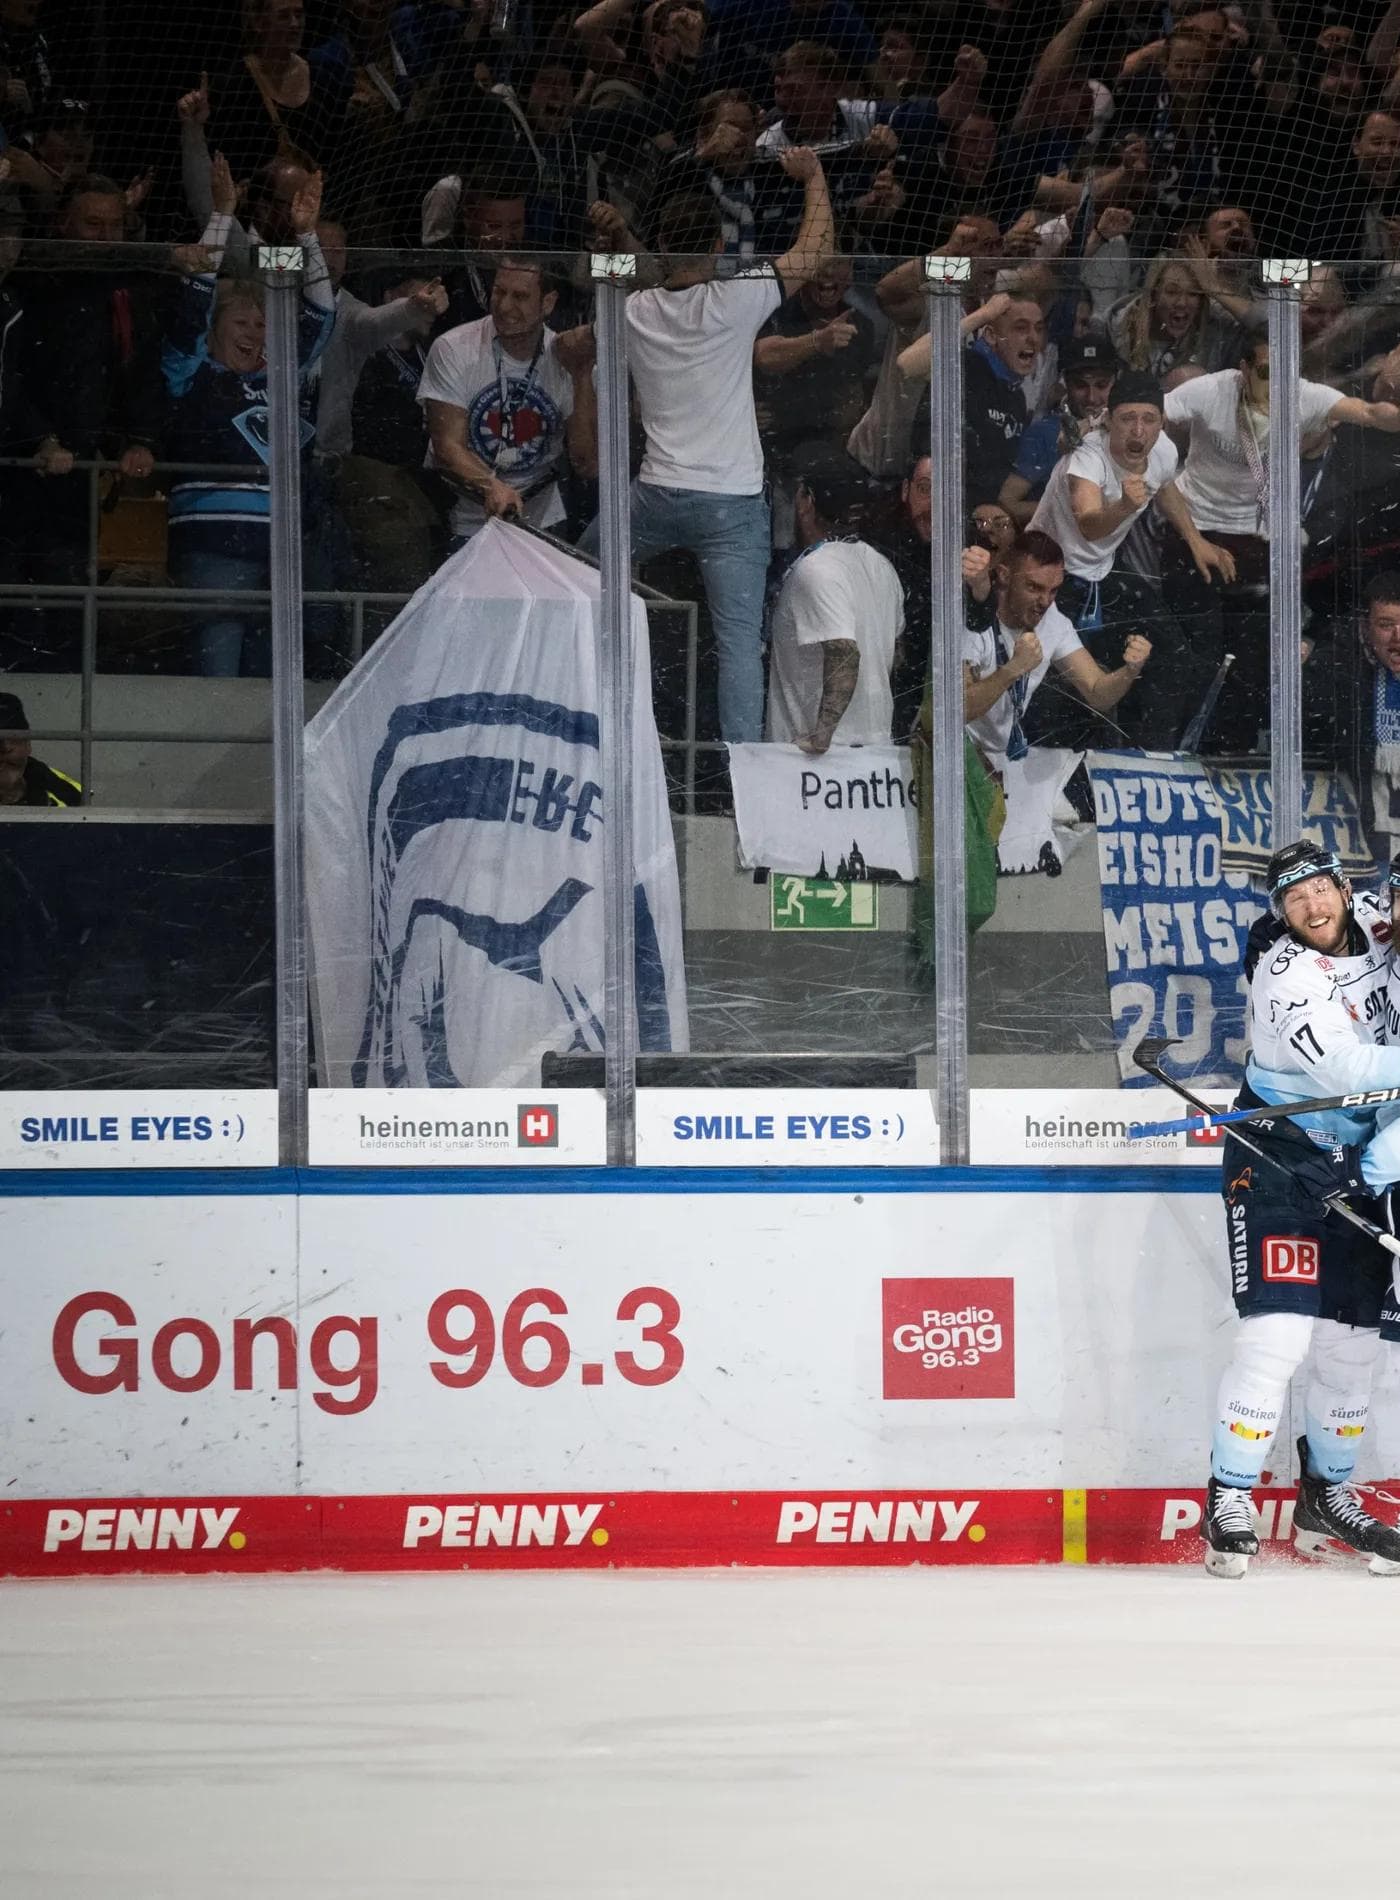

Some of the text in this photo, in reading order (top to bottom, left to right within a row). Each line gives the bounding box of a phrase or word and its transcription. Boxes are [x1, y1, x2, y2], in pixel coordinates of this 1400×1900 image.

[1288, 1022, 1325, 1066] 17
[20, 1116, 120, 1142] SMILE
[131, 1115, 213, 1141] EYES
[360, 1114, 510, 1138] heinemann
[673, 1115, 776, 1141] SMILE
[787, 1115, 872, 1141] EYES
[1231, 1205, 1249, 1295] SATURN
[1270, 1240, 1318, 1276] DB
[922, 1307, 995, 1328] Radio
[51, 1286, 686, 1416] Gong 96.3
[893, 1322, 1004, 1354] Gong
[921, 1348, 982, 1370] 96.3
